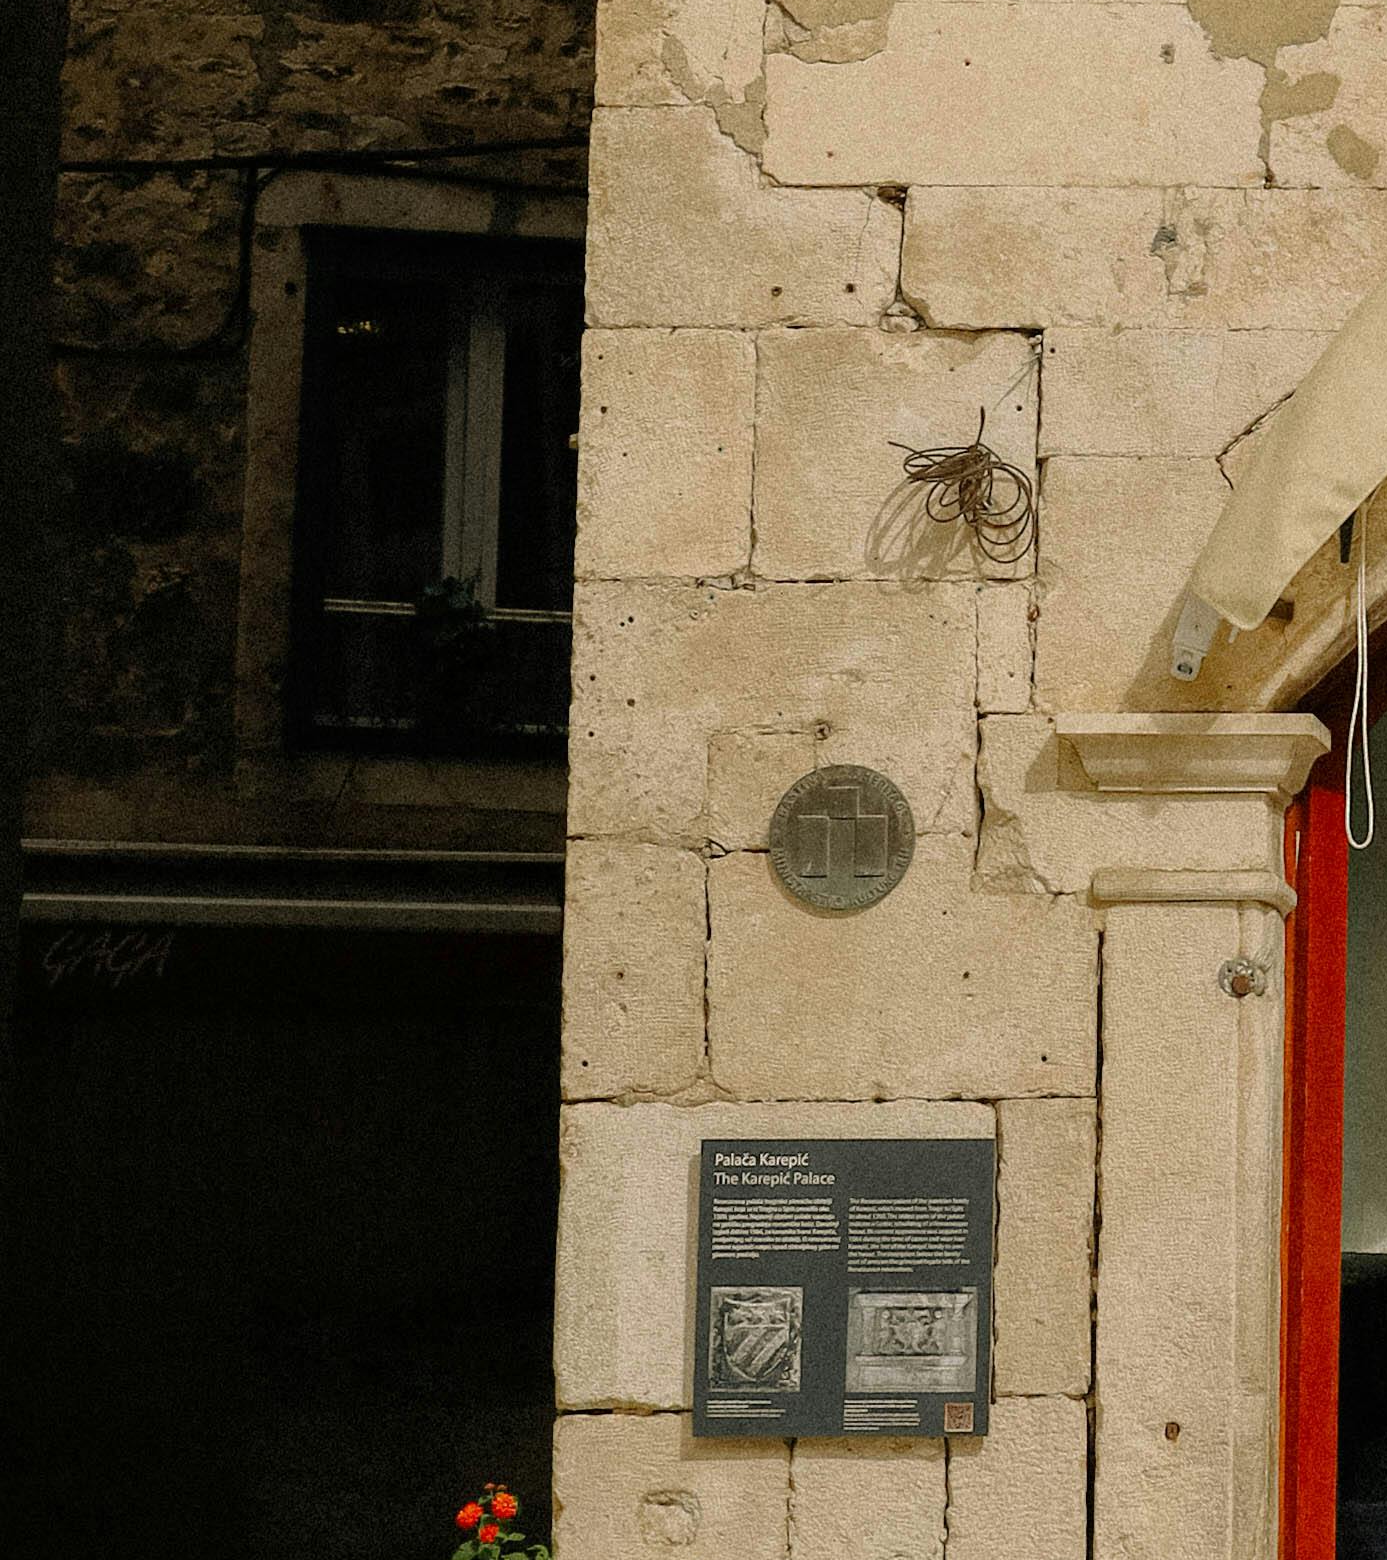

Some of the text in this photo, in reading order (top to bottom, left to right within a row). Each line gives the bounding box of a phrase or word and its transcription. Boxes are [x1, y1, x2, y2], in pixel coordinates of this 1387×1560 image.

[714, 1151, 810, 1169] Palača Karepić
[713, 1170, 837, 1188] The Karepić Palace
